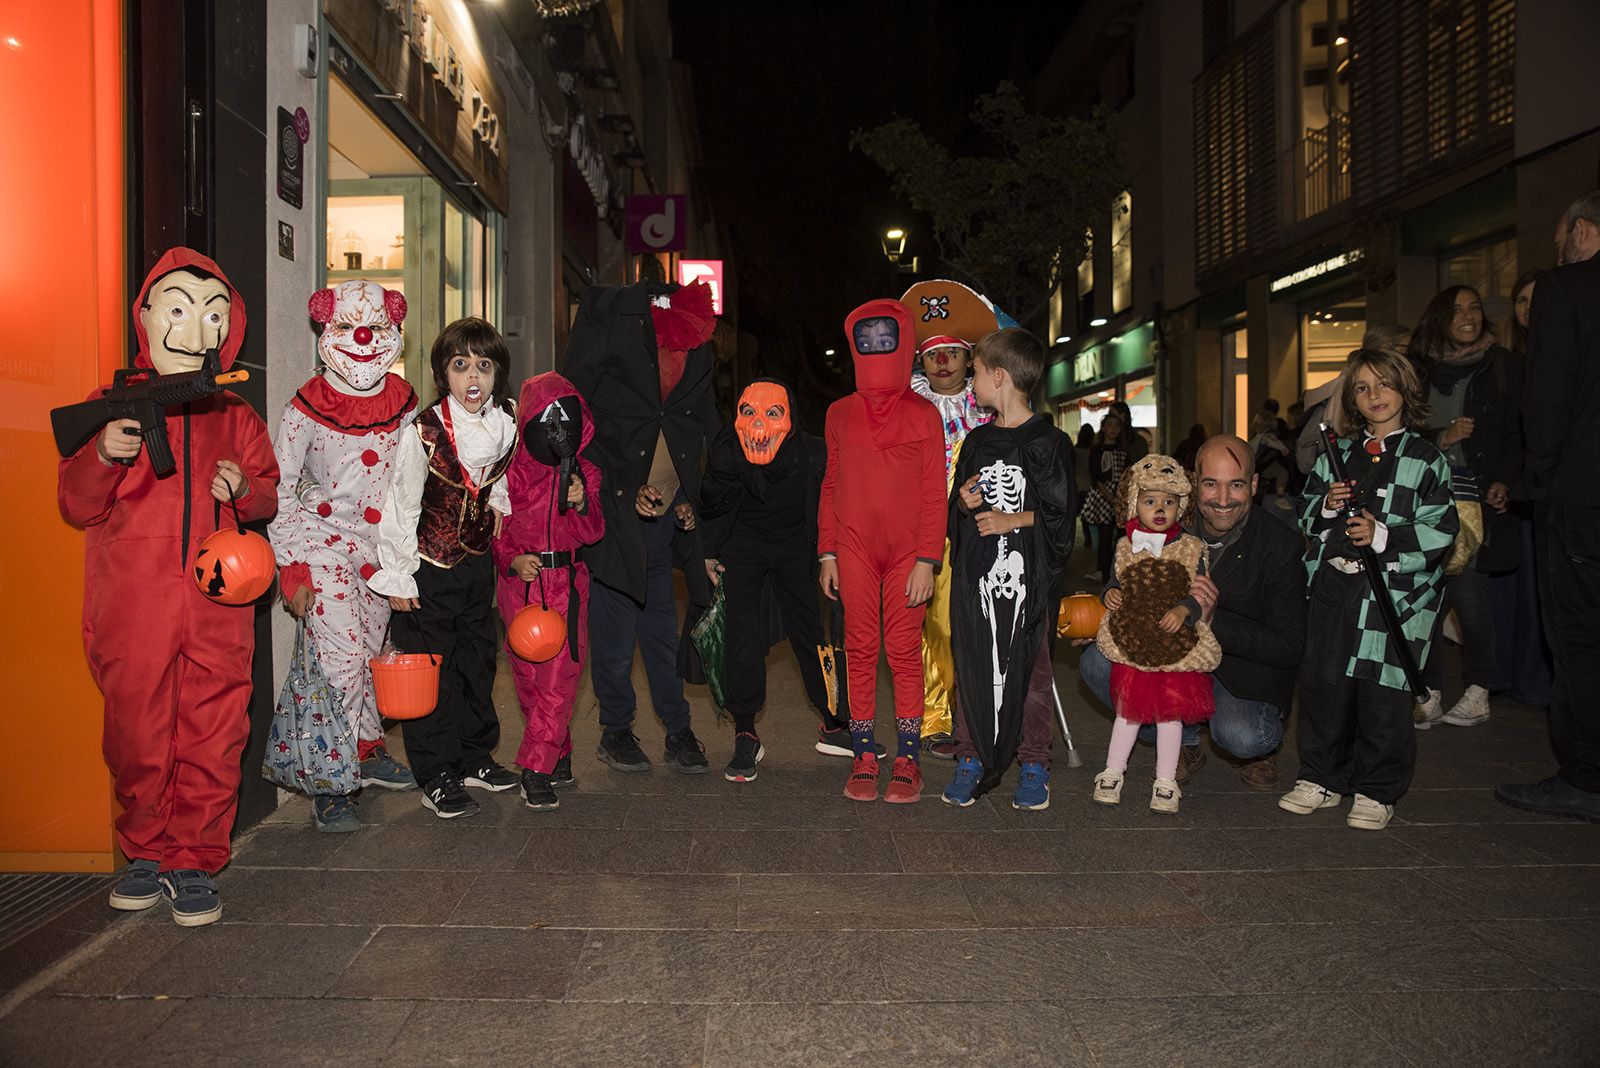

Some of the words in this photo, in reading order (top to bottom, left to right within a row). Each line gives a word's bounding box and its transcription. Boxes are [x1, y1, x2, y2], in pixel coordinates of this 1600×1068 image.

[640, 198, 676, 248] d
[852, 773, 874, 781] PUMA
[890, 775, 913, 785] PUMA
